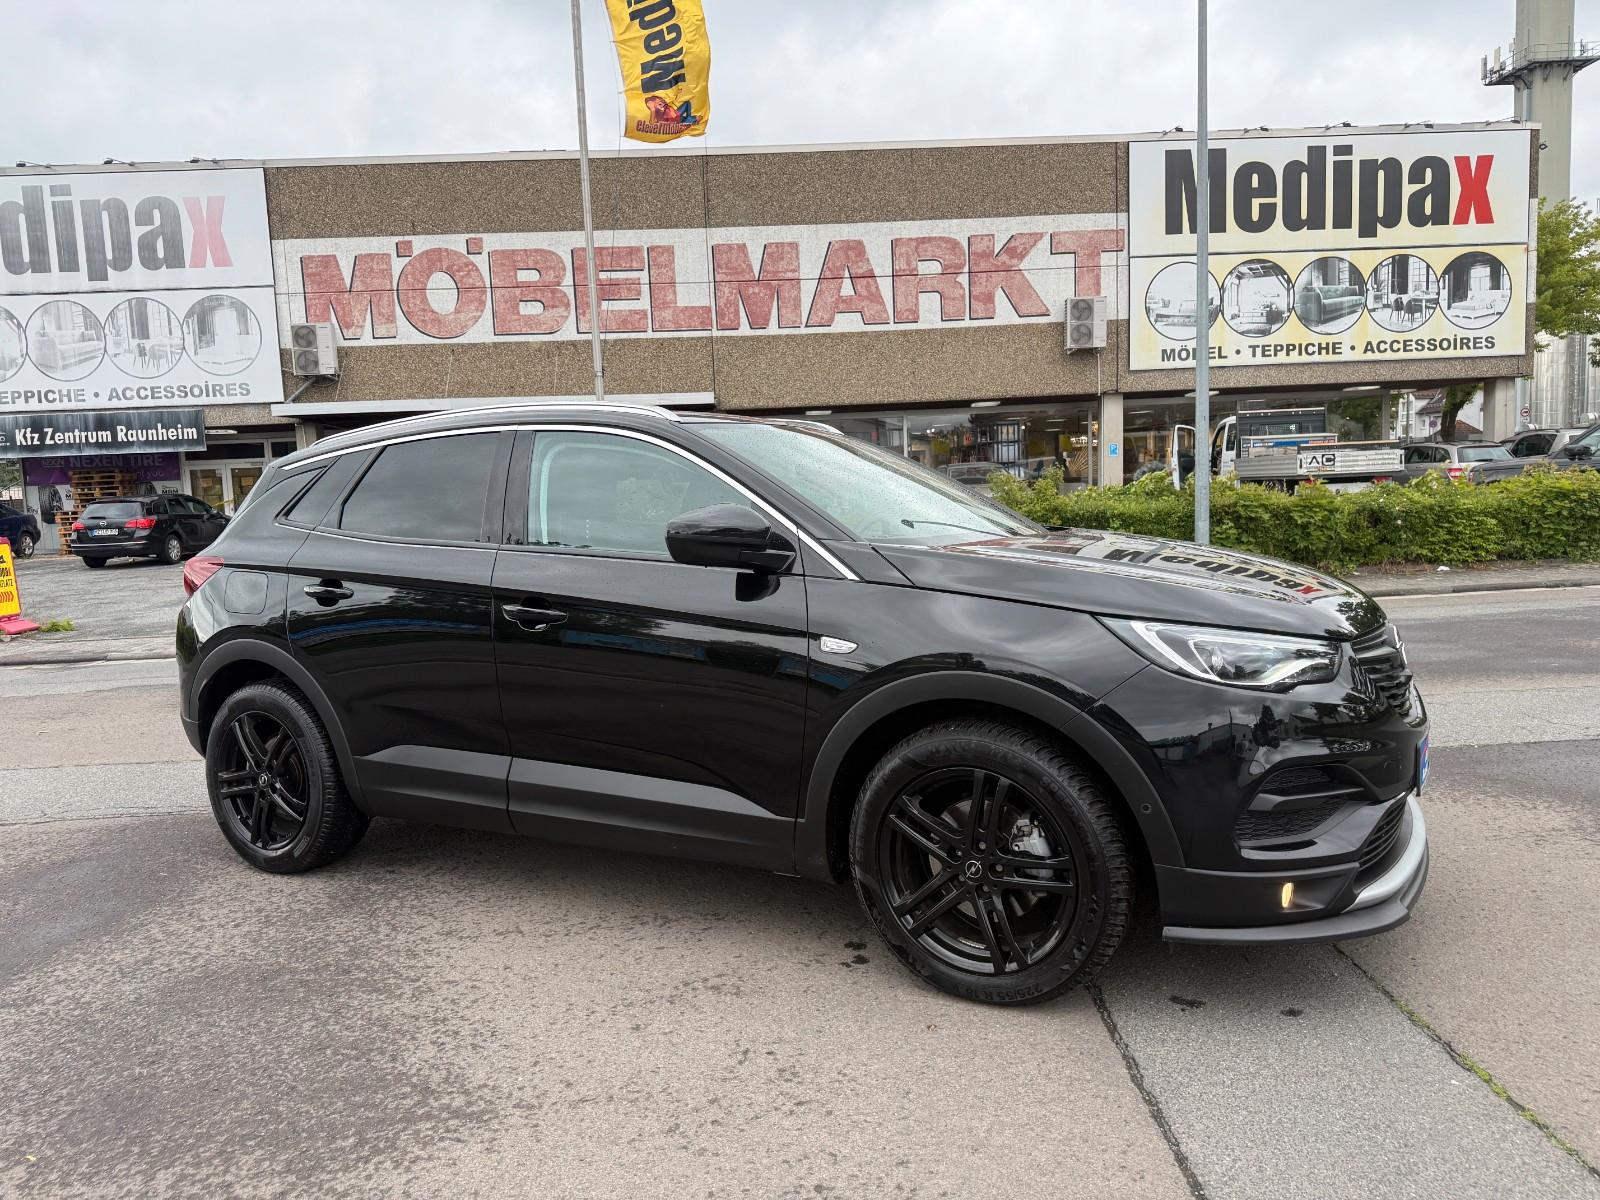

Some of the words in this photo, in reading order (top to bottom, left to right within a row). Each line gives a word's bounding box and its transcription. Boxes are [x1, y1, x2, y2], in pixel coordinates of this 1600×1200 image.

[627, 0, 686, 93] Med
[1165, 145, 1494, 238] Medipax
[0, 184, 233, 281] dipax
[300, 228, 1125, 340] MÖBELMARKT
[1248, 342, 1343, 358] TEPPICHE
[0, 388, 86, 404] EPPICHE
[15, 427, 41, 446] Kfz
[44, 426, 112, 445] Zentrum
[117, 423, 198, 443] Raunheim
[70, 455, 123, 468] NEXEN
[127, 454, 165, 467] TIRE
